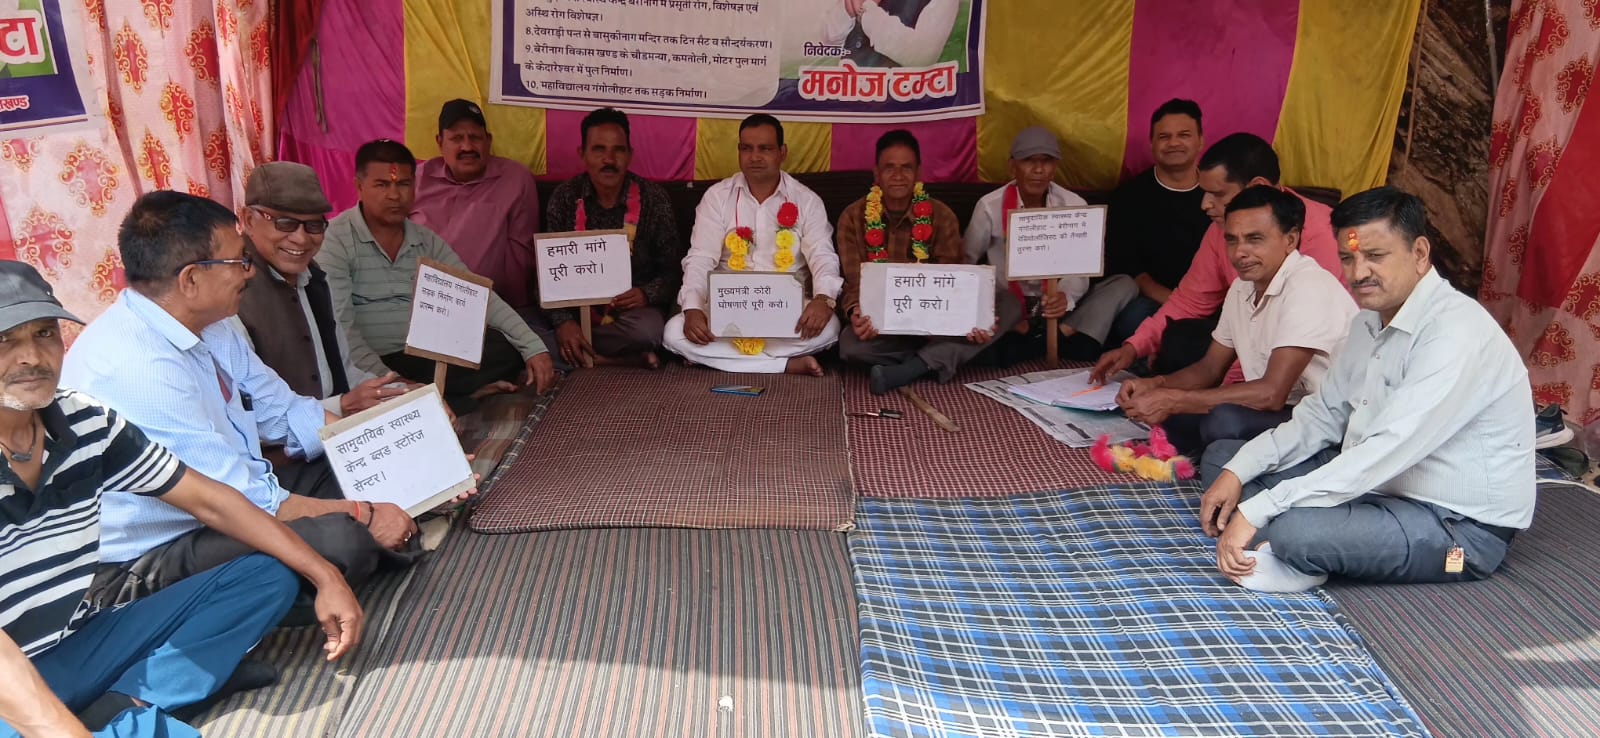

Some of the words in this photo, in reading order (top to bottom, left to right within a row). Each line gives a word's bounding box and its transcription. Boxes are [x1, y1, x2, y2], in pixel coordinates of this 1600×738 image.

[526, 6, 549, 18] अस्थि
[551, 8, 565, 19] रोग
[567, 9, 604, 22] विशेषज्ञ।
[746, 2, 759, 14] एवं
[566, 30, 582, 38] पन्त
[583, 28, 591, 38] से
[638, 32, 661, 44] मन्दिर
[663, 36, 678, 45] तक
[680, 34, 696, 46] टिन
[697, 34, 710, 46] सैट
[712, 38, 719, 46] व
[566, 44, 594, 57] विकास
[596, 49, 618, 60] खण्ड
[620, 48, 628, 59] के
[712, 53, 734, 65] मोटर
[735, 58, 749, 68] पुल
[750, 55, 768, 66] मार्ग
[525, 60, 534, 70] के
[536, 60, 575, 73] केदारेश्वर
[586, 66, 599, 77] पुल
[602, 64, 633, 77] निर्माण।
[526, 80, 539, 90] 10.
[541, 80, 590, 92] महाविद्यालय
[592, 82, 632, 96] गंगोलीहाट
[634, 86, 650, 96] तक
[652, 88, 674, 99] सड़क
[676, 86, 707, 98] निर्माण।
[802, 64, 887, 97] मनोज
[893, 66, 955, 97] टम्टा
[546, 241, 578, 257] हमारी
[584, 238, 607, 254] मांगे
[548, 264, 568, 282] पूरी
[893, 273, 926, 288] हमारी
[932, 274, 956, 288] मांगे
[438, 290, 454, 304] निर्माण
[752, 299, 764, 311] पूरी
[892, 295, 913, 314] पूरी
[336, 424, 386, 455] सामुदायिक
[388, 409, 422, 431] स्वास्थ्य
[344, 456, 367, 474] केन्द्र
[370, 445, 392, 462] ब्लड
[394, 429, 425, 450] स्टोरेज
[352, 470, 387, 493] सेन्टर।
